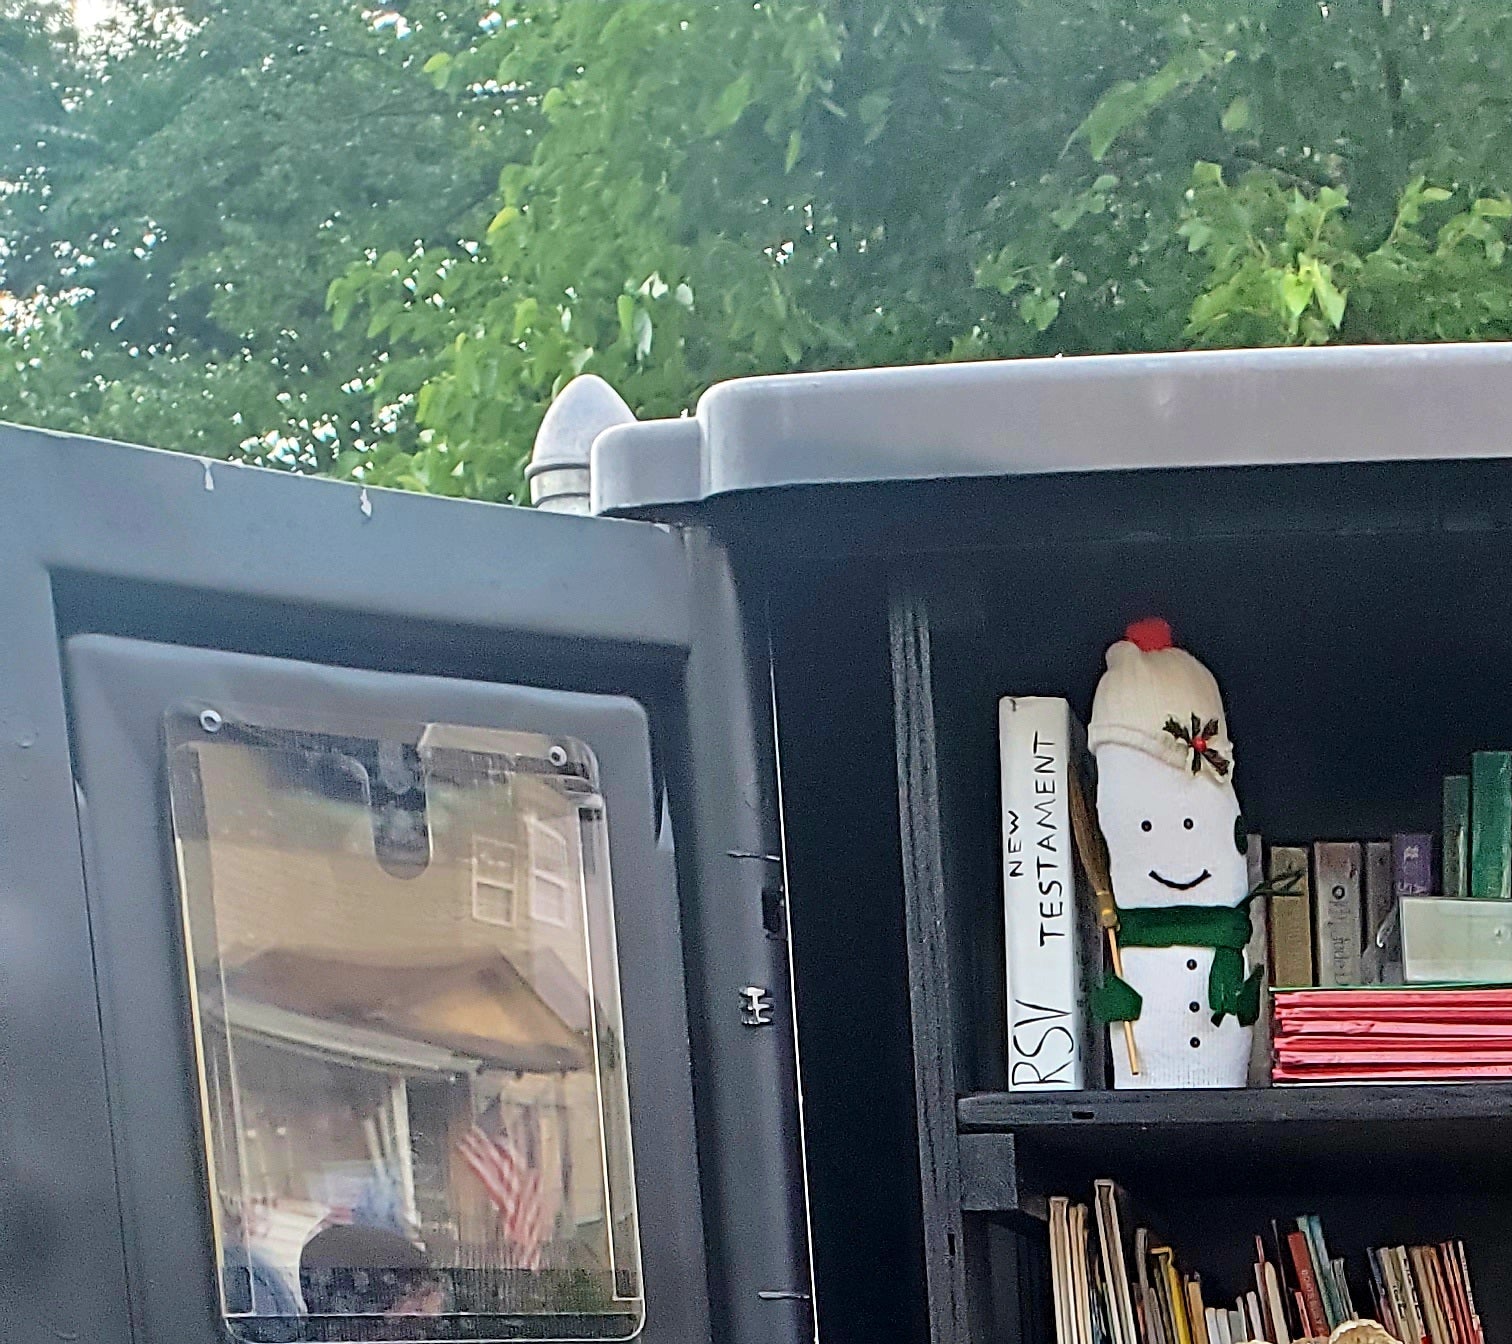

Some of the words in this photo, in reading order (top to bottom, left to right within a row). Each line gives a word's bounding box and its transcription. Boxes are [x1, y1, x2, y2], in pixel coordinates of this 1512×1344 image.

[1008, 810, 1023, 877] NEW
[1033, 731, 1065, 946] TESTAMENT
[1011, 999, 1074, 1088] RSV
